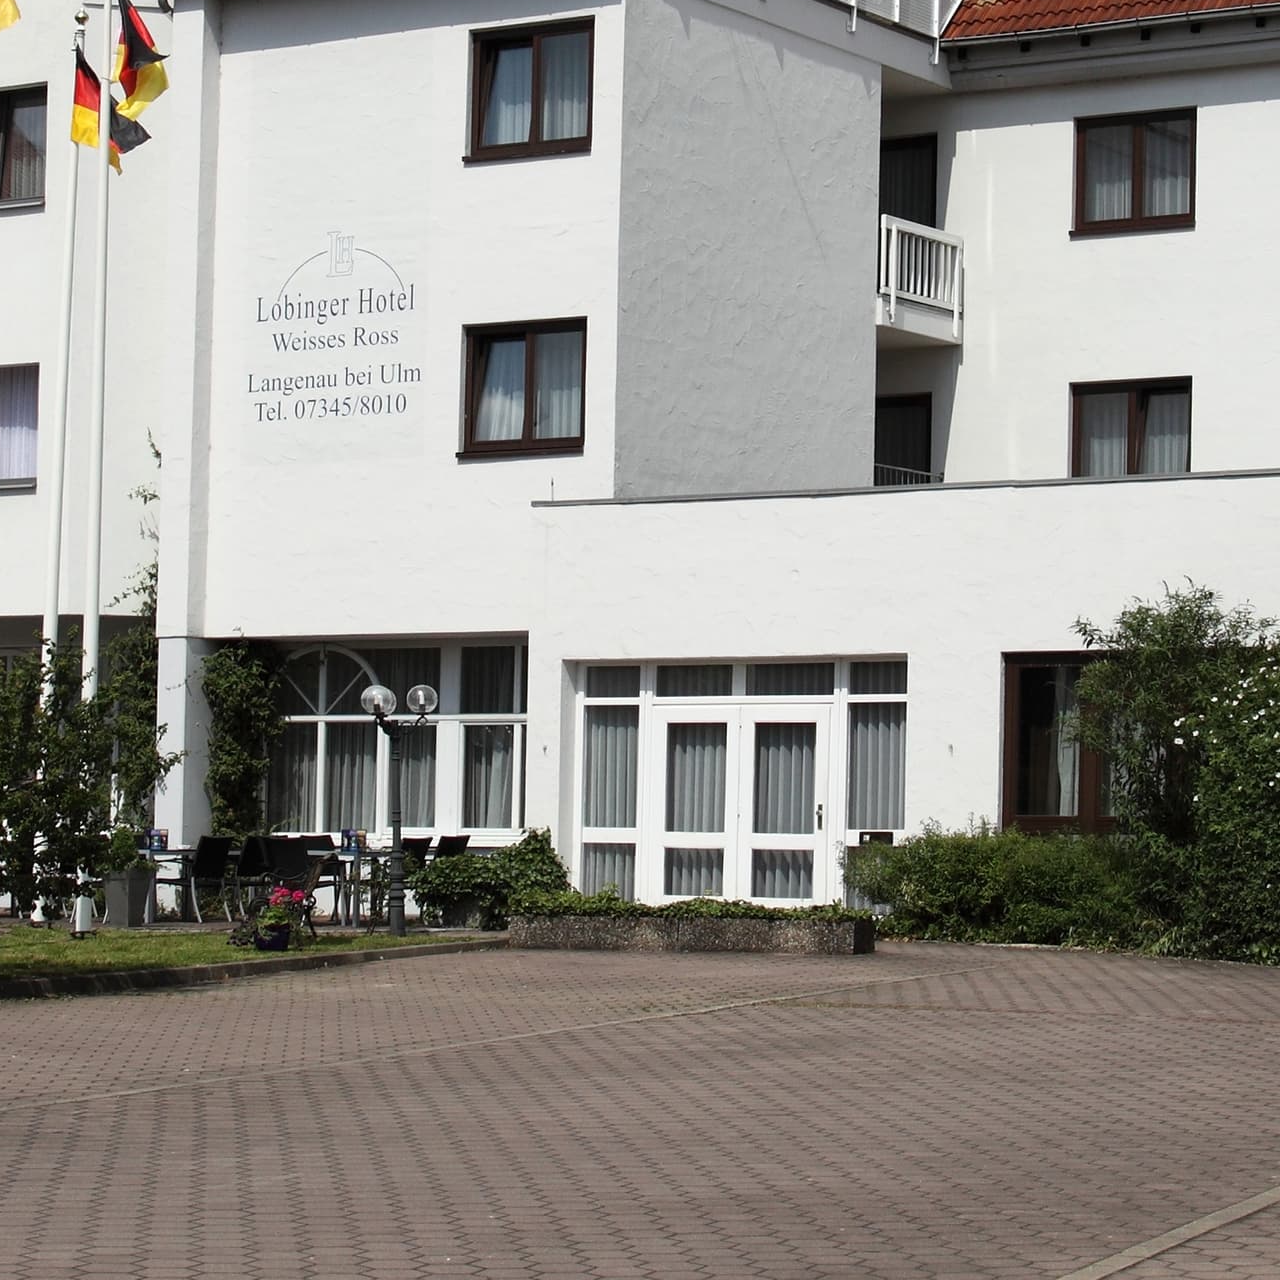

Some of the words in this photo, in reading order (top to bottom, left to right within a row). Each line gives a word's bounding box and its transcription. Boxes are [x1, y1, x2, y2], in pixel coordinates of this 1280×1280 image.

[256, 292, 350, 325] Lobinger
[358, 283, 415, 315] Hotel
[272, 331, 346, 353] Weisses
[353, 326, 400, 347] Ross
[247, 372, 337, 396] Langenau
[344, 364, 372, 386] bei
[380, 363, 421, 384] Ulm
[254, 401, 288, 422] Tel.
[294, 393, 408, 419] 07345/8010
